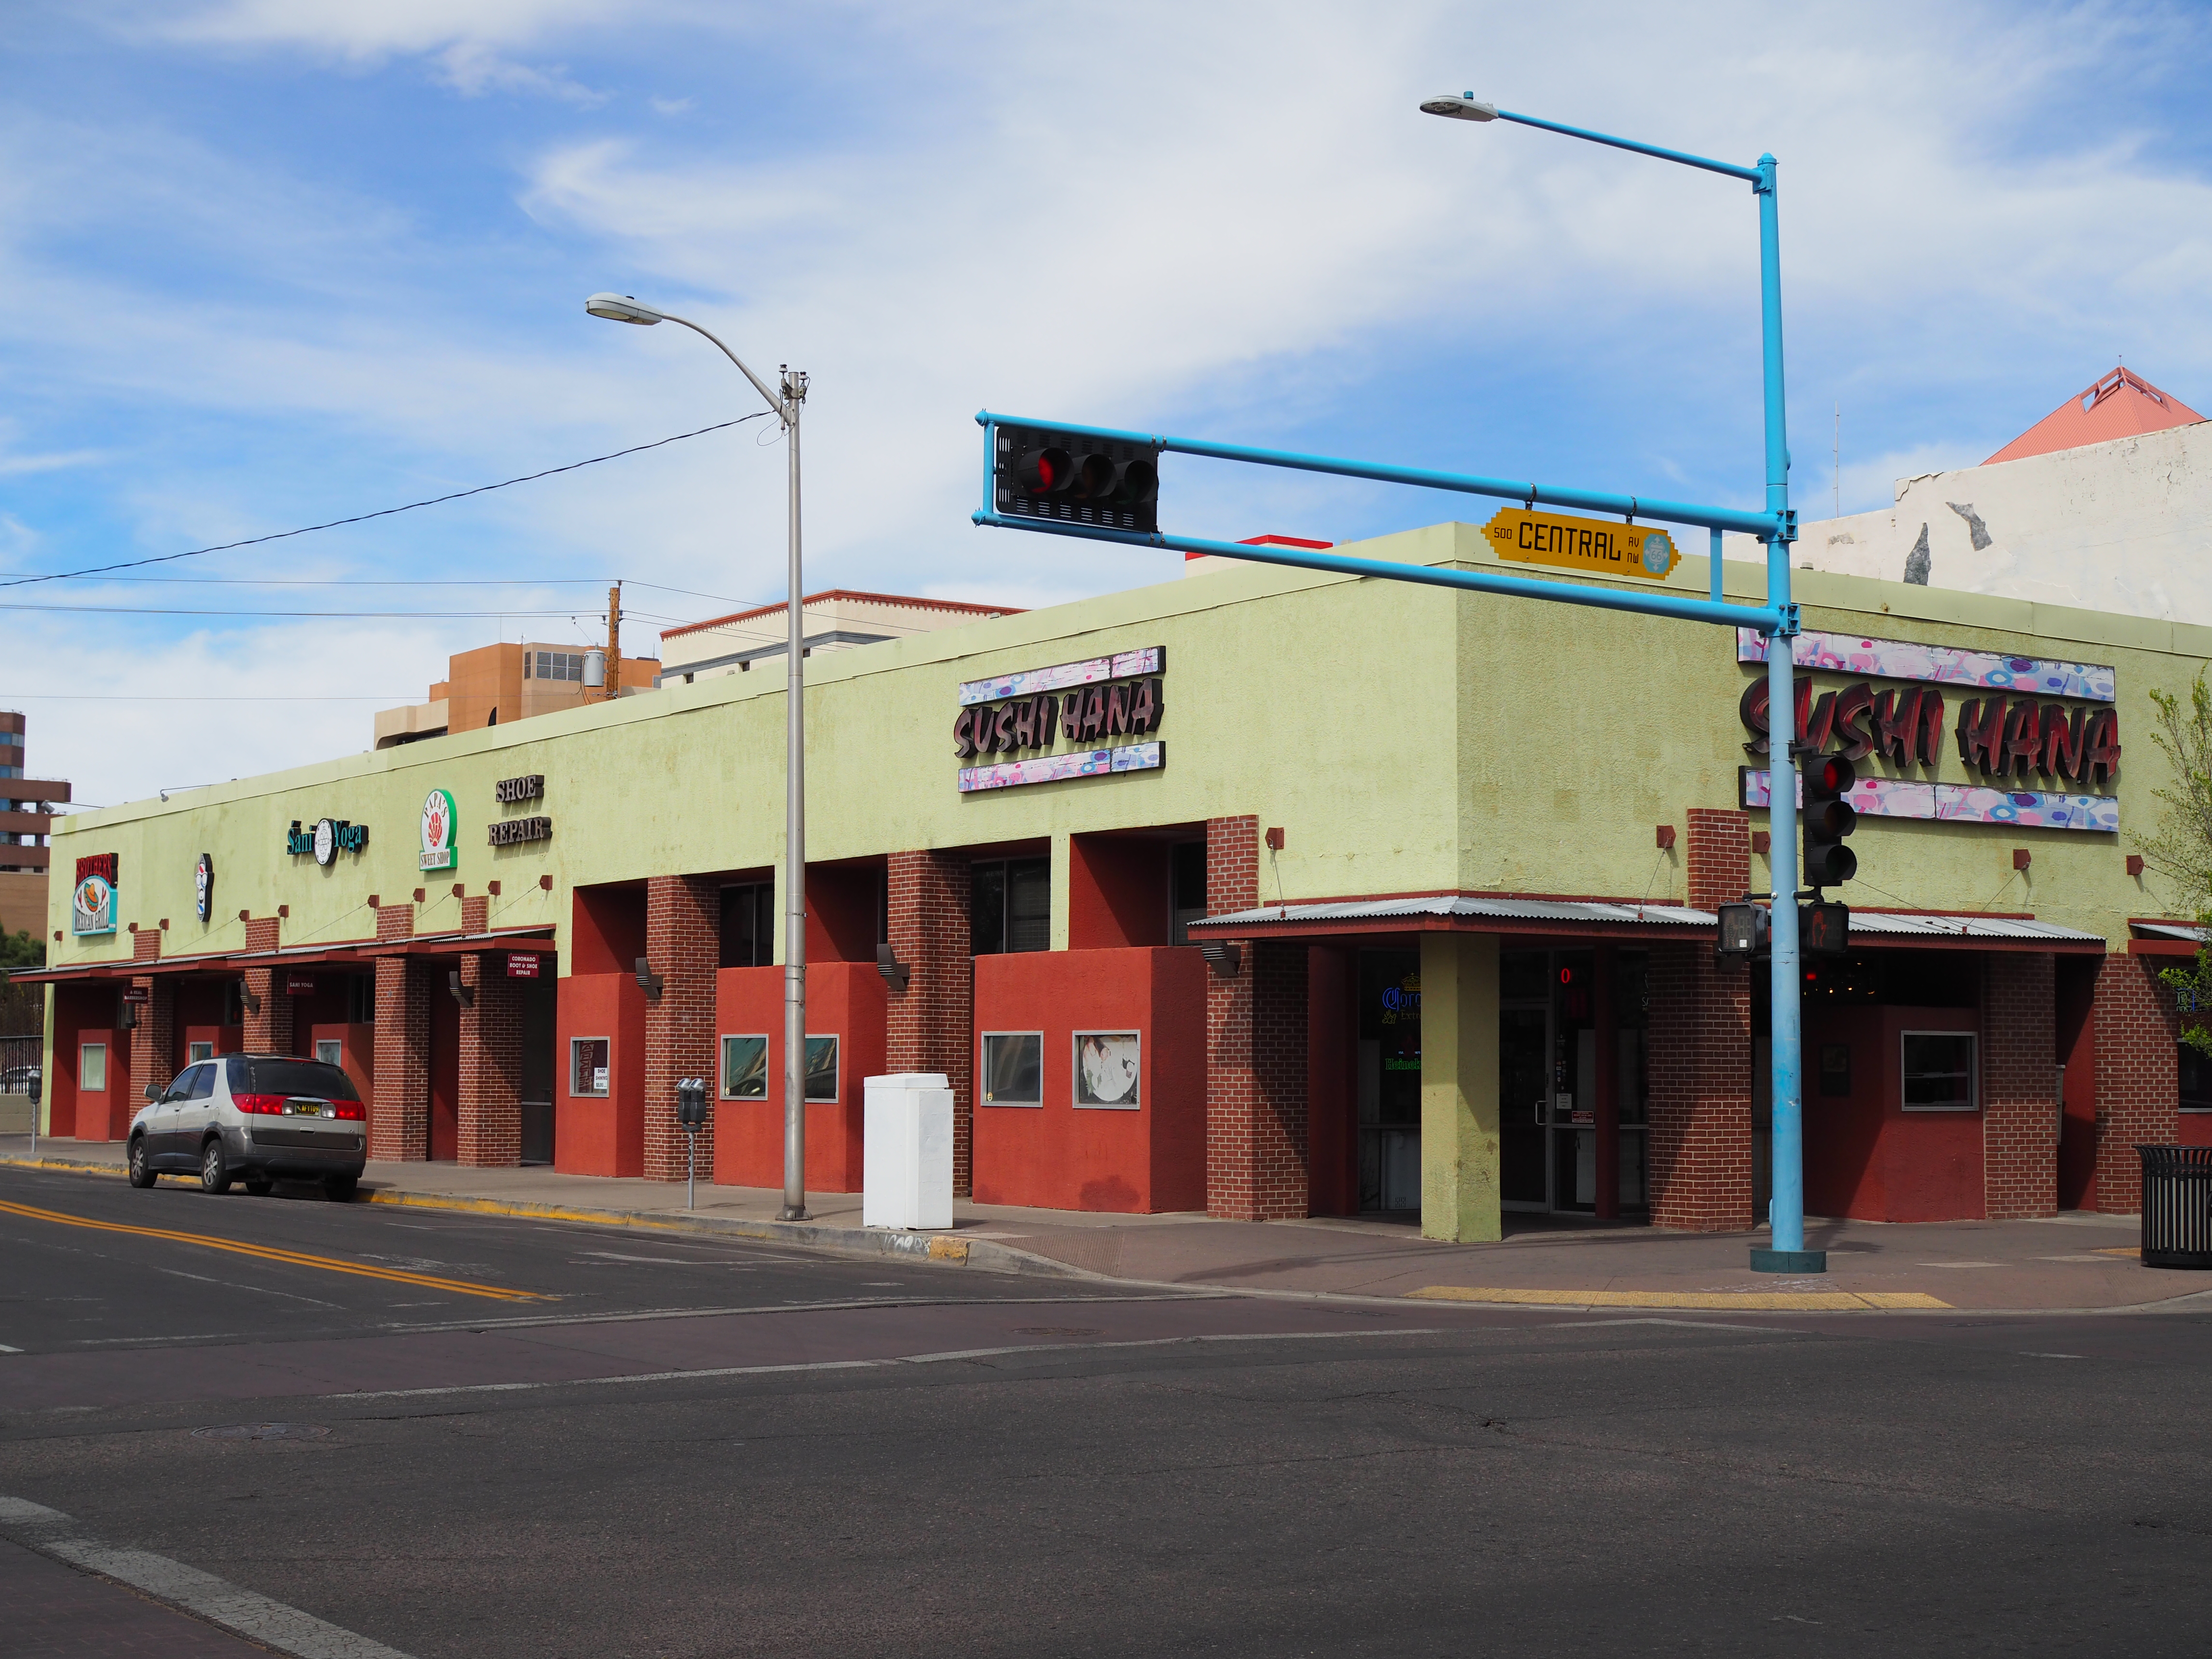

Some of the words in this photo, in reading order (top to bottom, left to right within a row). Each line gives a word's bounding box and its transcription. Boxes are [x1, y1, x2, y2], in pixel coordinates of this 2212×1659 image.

[1494, 527, 1512, 540] 500
[1519, 521, 1621, 561] CENTRAL
[1628, 536, 1639, 548] AV
[1650, 549, 1662, 561] 66
[1627, 553, 1639, 564] NW
[954, 696, 1059, 758] SUSHI
[1060, 678, 1164, 743] HANA
[1741, 675, 1945, 768] SUSHI
[1955, 695, 2122, 785] HANA
[496, 775, 541, 803] SHOE
[424, 793, 448, 819] PAPA'S
[333, 819, 366, 853] Yoga
[488, 817, 550, 845] REPAIR
[75, 853, 114, 890] BROTHERS
[421, 853, 436, 867] SWEET
[437, 851, 449, 865] SHOP
[74, 904, 94, 932] MEXICAN
[95, 901, 109, 929] GRILL
